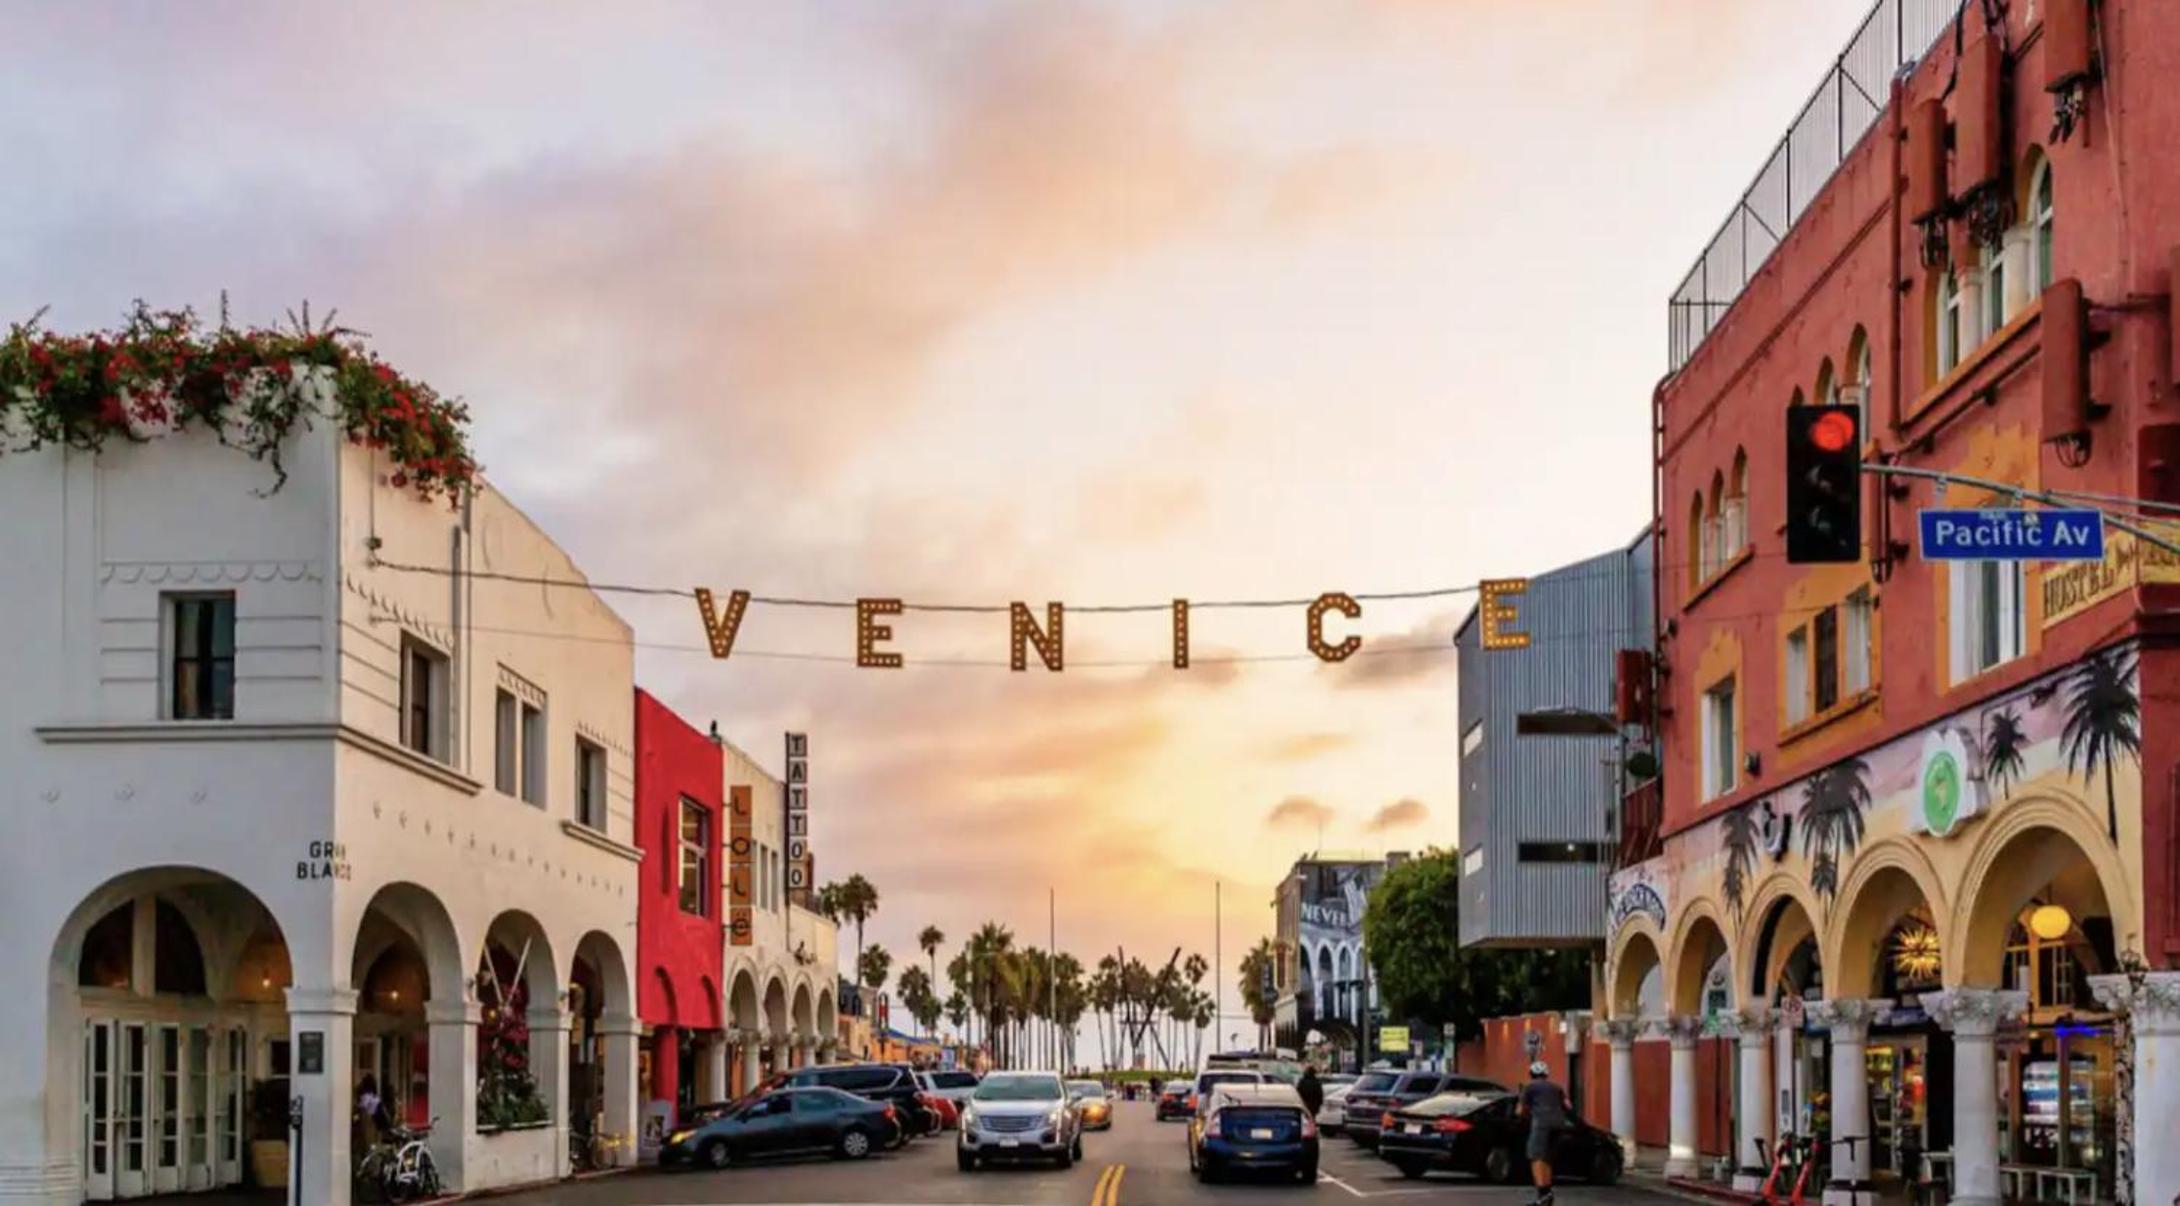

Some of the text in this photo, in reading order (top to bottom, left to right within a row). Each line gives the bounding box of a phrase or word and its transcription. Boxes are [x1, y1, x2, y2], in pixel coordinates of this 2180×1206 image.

[1935, 520, 2089, 547] Pacific Av
[693, 577, 1532, 672] VENICE
[790, 735, 805, 886] TATTOO
